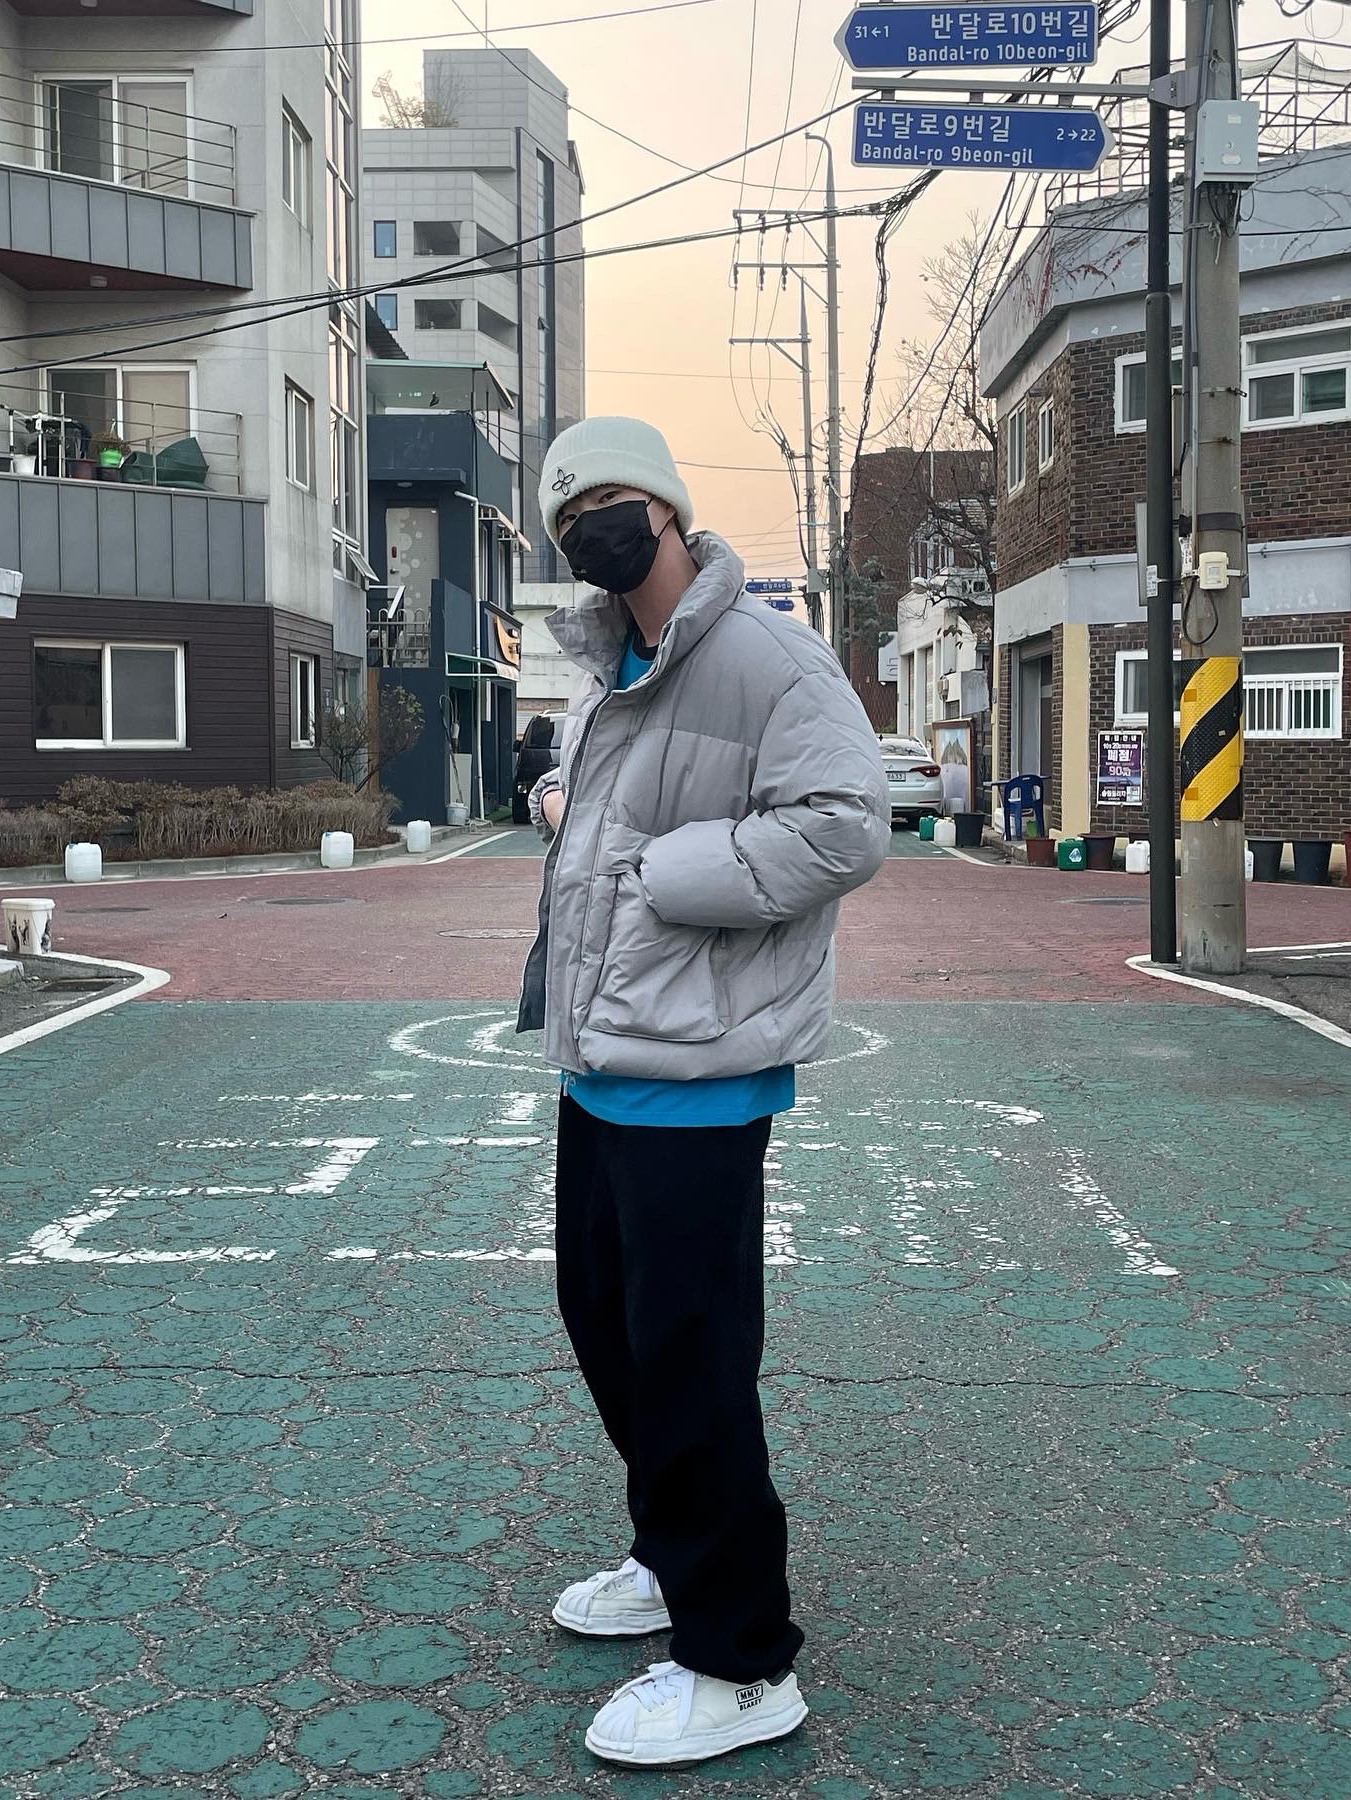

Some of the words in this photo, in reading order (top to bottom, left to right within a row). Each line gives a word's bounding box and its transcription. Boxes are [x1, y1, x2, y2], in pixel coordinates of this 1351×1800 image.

[854, 25, 868, 39] 31
[884, 25, 890, 38] 1
[931, 10, 1088, 40] 반달로10번길
[907, 46, 989, 62] Bandal-ro
[997, 43, 1088, 61] 10beon-gil
[863, 111, 1011, 143] 반달로9번길
[1056, 127, 1064, 141] 2
[1080, 128, 1097, 141] 22
[862, 143, 943, 161] Bandal-ro
[951, 146, 1033, 165] 9beon-gil
[740, 1687, 760, 1700] MMY
